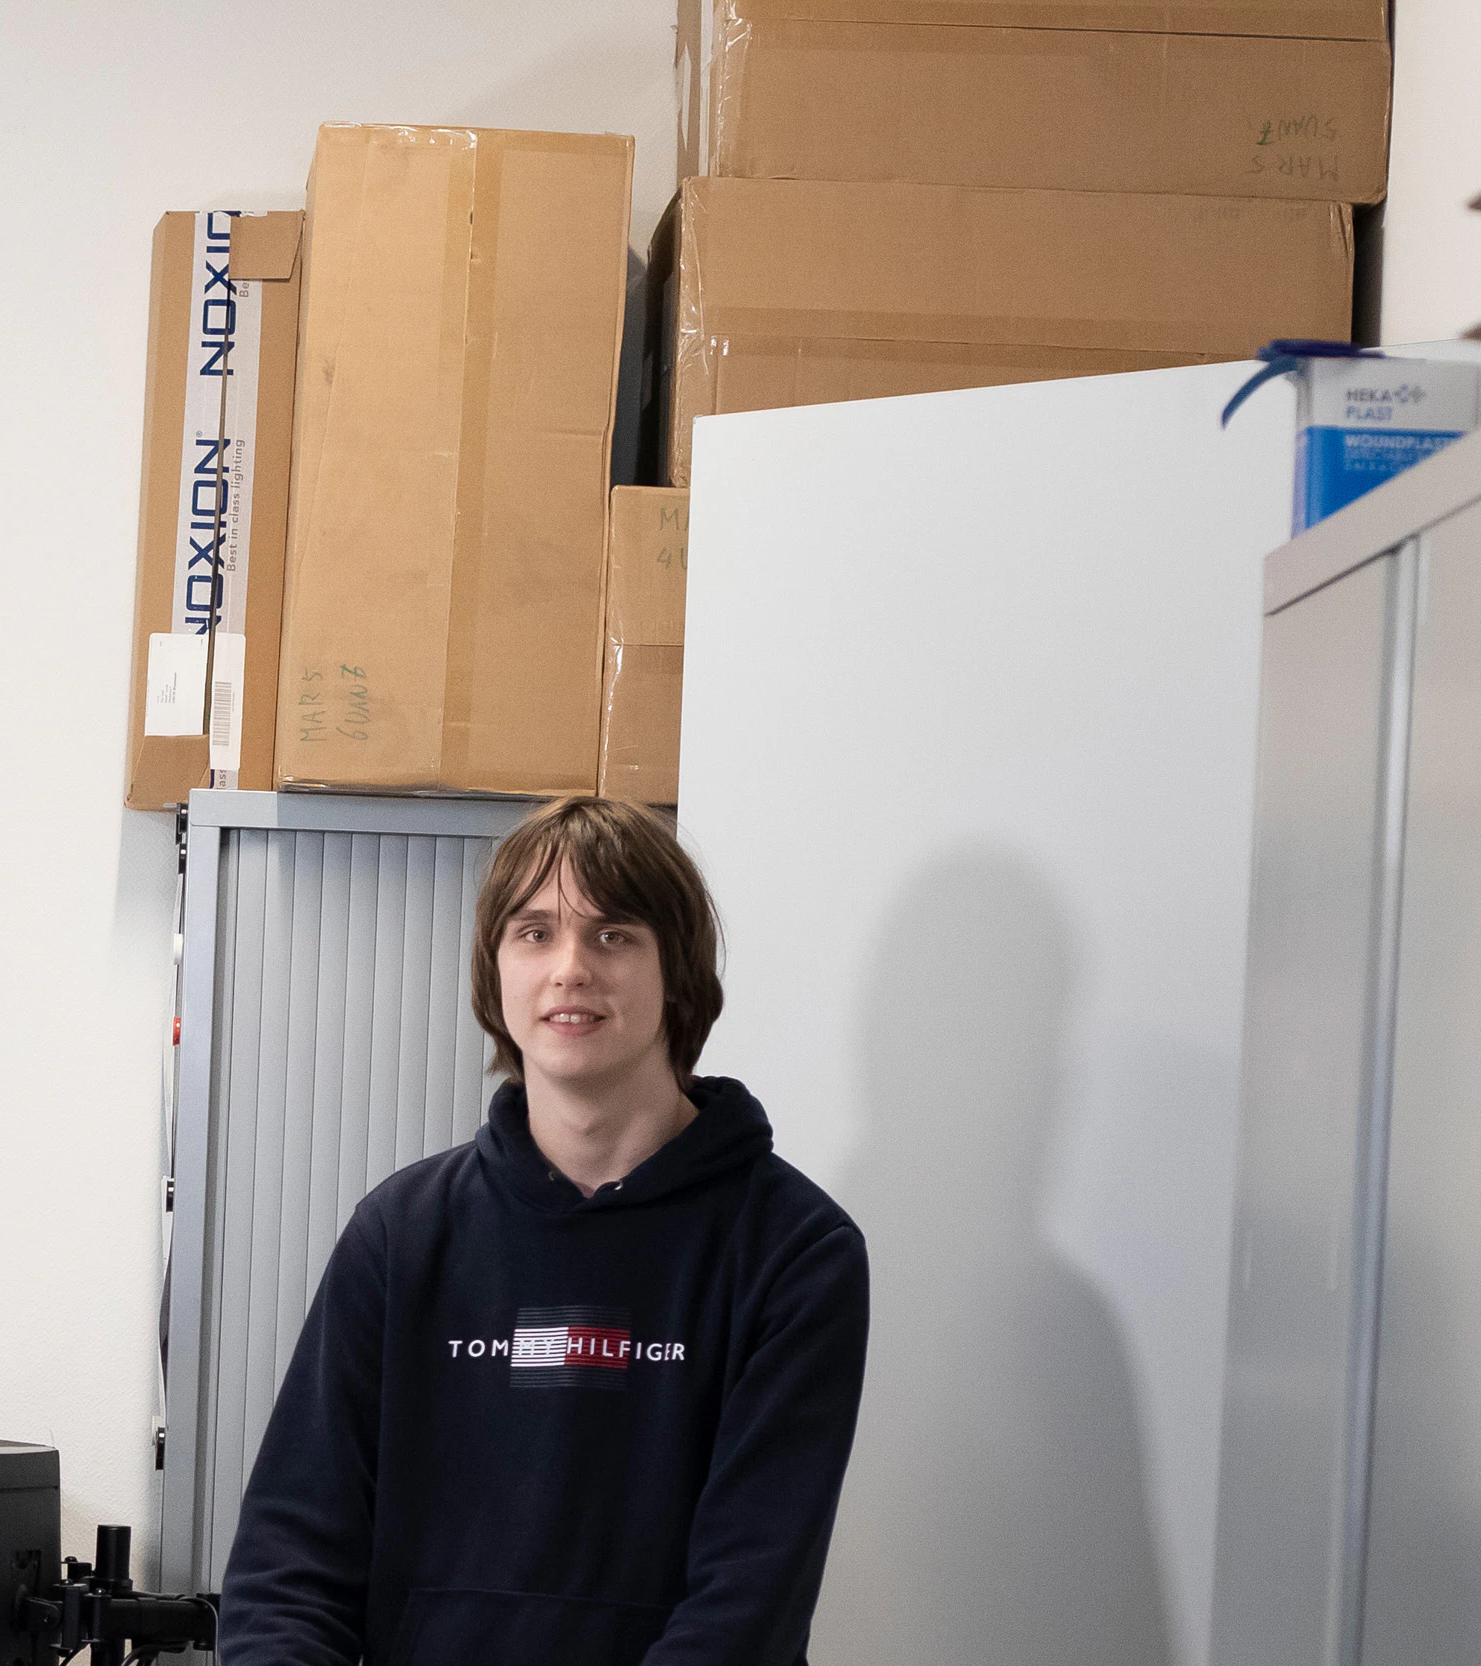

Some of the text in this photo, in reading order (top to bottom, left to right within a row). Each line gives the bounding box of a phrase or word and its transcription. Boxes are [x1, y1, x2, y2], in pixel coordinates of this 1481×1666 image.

[1345, 387, 1393, 402] HEKA
[1345, 405, 1393, 421] PLAST
[226, 439, 245, 572] Best in class lighting
[448, 1338, 555, 1358] TOMMY
